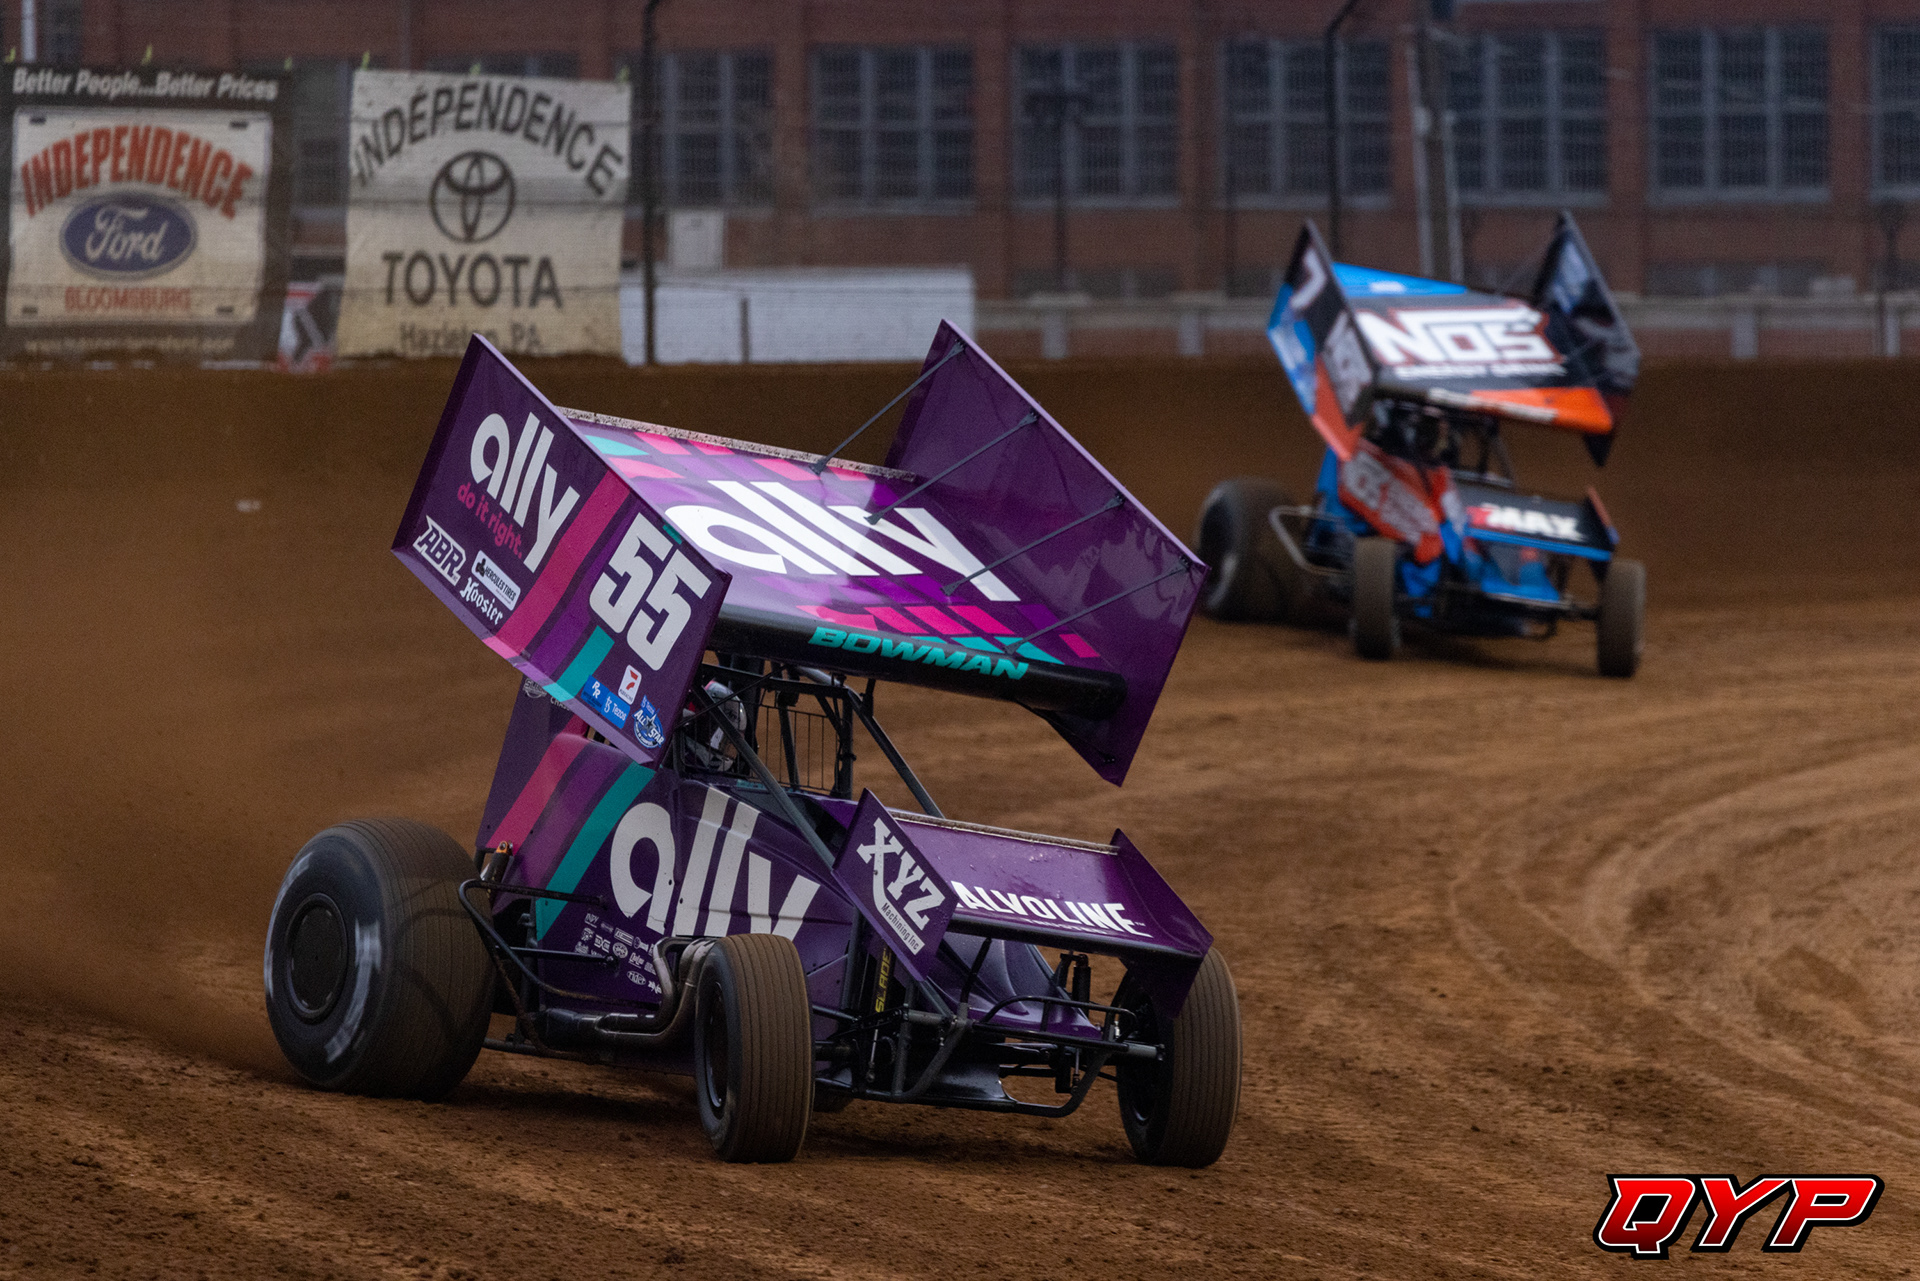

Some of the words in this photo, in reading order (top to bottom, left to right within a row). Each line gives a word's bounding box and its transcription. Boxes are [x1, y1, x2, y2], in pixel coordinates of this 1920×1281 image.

[12, 67, 72, 95] Better
[217, 73, 279, 101] Prices
[354, 81, 624, 196] INDEPENDENCE
[21, 125, 254, 220] INDEPENDENCE
[85, 206, 169, 262] Ford
[381, 251, 564, 309] TOYOTA
[1352, 304, 1556, 365] NOS
[457, 482, 476, 509] do
[475, 494, 489, 522] it
[488, 512, 523, 559] right.
[470, 411, 581, 573] ally
[664, 479, 1021, 602] ally
[460, 577, 503, 625] Hoosier
[484, 566, 506, 591] HERCULES
[502, 582, 517, 602] TIRES
[589, 512, 712, 671] 55
[807, 625, 1029, 680] BOWMAN
[648, 728, 665, 745] STAR
[610, 786, 821, 942] ally
[856, 816, 946, 931] XYZ
[881, 902, 910, 942] Machining
[908, 934, 920, 951] Inc
[951, 880, 1154, 938] ALVOLINE
